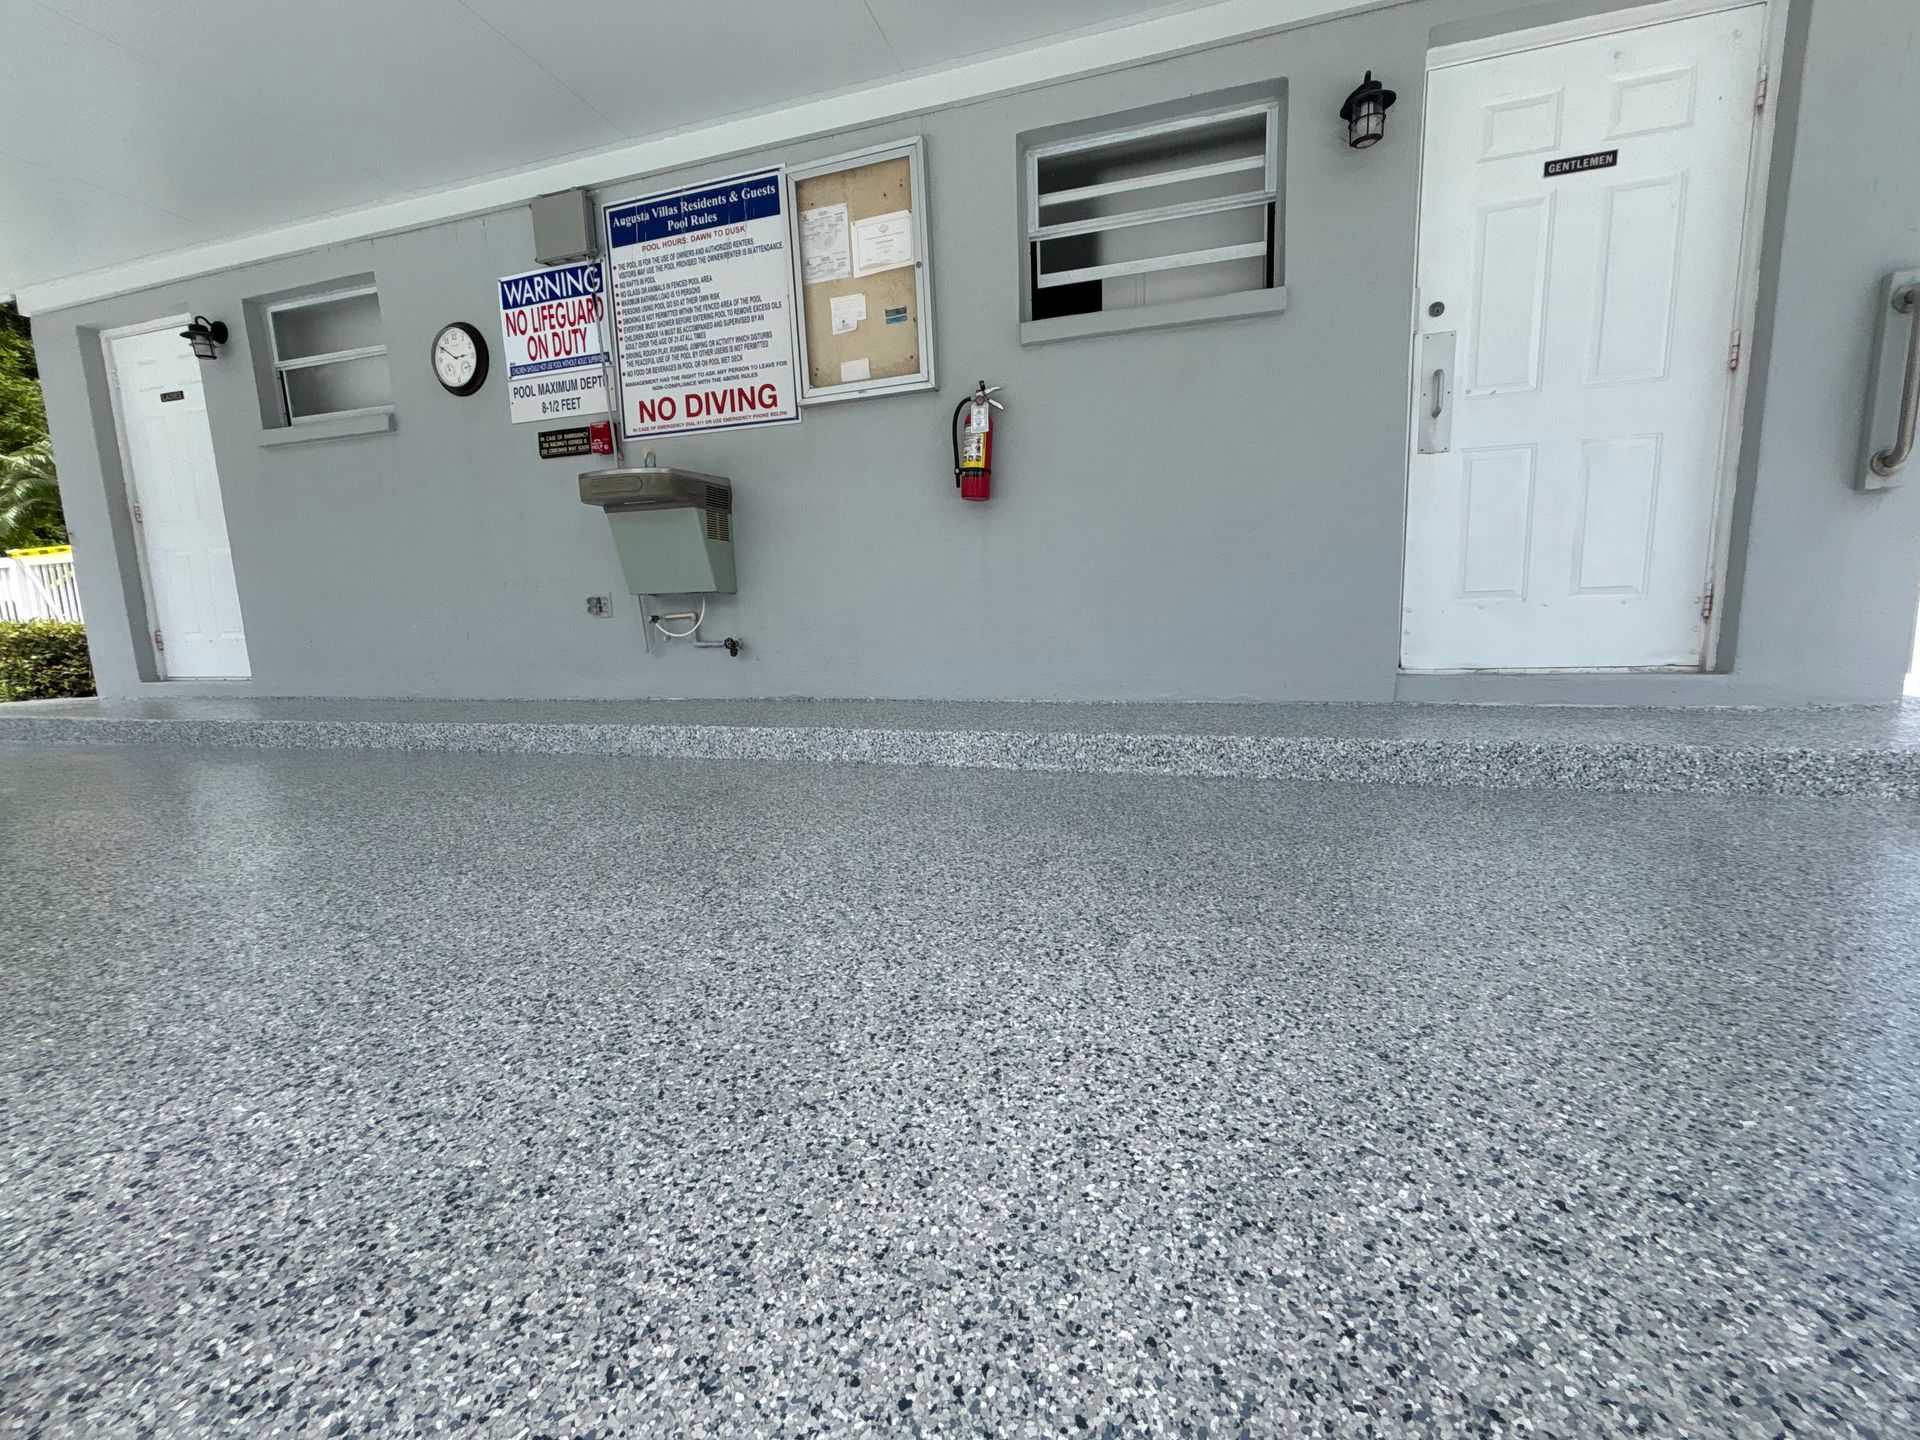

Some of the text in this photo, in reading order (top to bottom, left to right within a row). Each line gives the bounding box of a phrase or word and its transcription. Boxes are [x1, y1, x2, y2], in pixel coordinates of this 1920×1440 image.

[1548, 154, 1613, 173] GENTLEMEN
[612, 184, 775, 228] Augusta Villas Residents & Guests
[667, 212, 717, 231] Pool Rules
[642, 226, 745, 252] POOL HOURS: DAWN TO DUSK
[626, 261, 637, 269] POOL
[643, 258, 651, 266] FOR
[652, 256, 660, 264] THE
[661, 254, 669, 262] USE
[676, 249, 694, 259] OWNERS
[705, 242, 732, 254] AUTHORIZED
[619, 270, 636, 279] VISITORS
[637, 268, 645, 276] MAY
[646, 266, 654, 274] USE
[664, 262, 675, 271] POOL
[676, 258, 697, 268] PROVIDED
[698, 256, 706, 264] THE
[504, 266, 601, 306] WARNING
[627, 279, 639, 288] RAFTS
[645, 276, 656, 284] POOL
[648, 284, 665, 293] ANIMALS
[671, 280, 687, 289] FENCED
[689, 278, 700, 286] POOL
[701, 275, 712, 283] AREA
[622, 307, 640, 316] PERSONS
[686, 297, 698, 305] THEIR
[710, 293, 720, 301] RISK
[623, 316, 641, 325] SMOKING
[656, 310, 678, 319] PERMITTED
[679, 307, 693, 315] WITHIN
[694, 305, 702, 313] THE
[703, 302, 720, 311] FENCED
[721, 300, 732, 308] AREA
[740, 297, 749, 305] THE
[750, 295, 762, 304] POOL
[506, 309, 528, 337] NO
[624, 324, 644, 333] EVERYONE
[645, 322, 656, 330] MUST
[657, 319, 674, 328] SHOWER
[676, 316, 692, 325] BEFORE
[693, 313, 714, 322] ENTERING
[734, 306, 752, 315] REMOVE
[753, 303, 770, 312] EXCESS
[772, 301, 782, 309] OILS
[527, 327, 588, 361] ON DUTY
[694, 332, 706, 340] TIMES
[635, 358, 655, 366] PEACEFUL
[680, 352, 691, 360] POOL
[699, 349, 713, 357] OTHER
[714, 347, 728, 355] USERS
[744, 341, 768, 350] PERMITTED
[653, 364, 676, 374] BEVERAGES
[709, 358, 720, 366] POOL
[513, 385, 536, 399] POOL
[538, 379, 578, 396] MAXIMUM
[625, 379, 658, 387] MANAGEMENT
[652, 381, 696, 391] NON-COMPLIANCE
[542, 397, 581, 414] 8-1/2 FEET
[639, 383, 778, 424] NO DIVING
